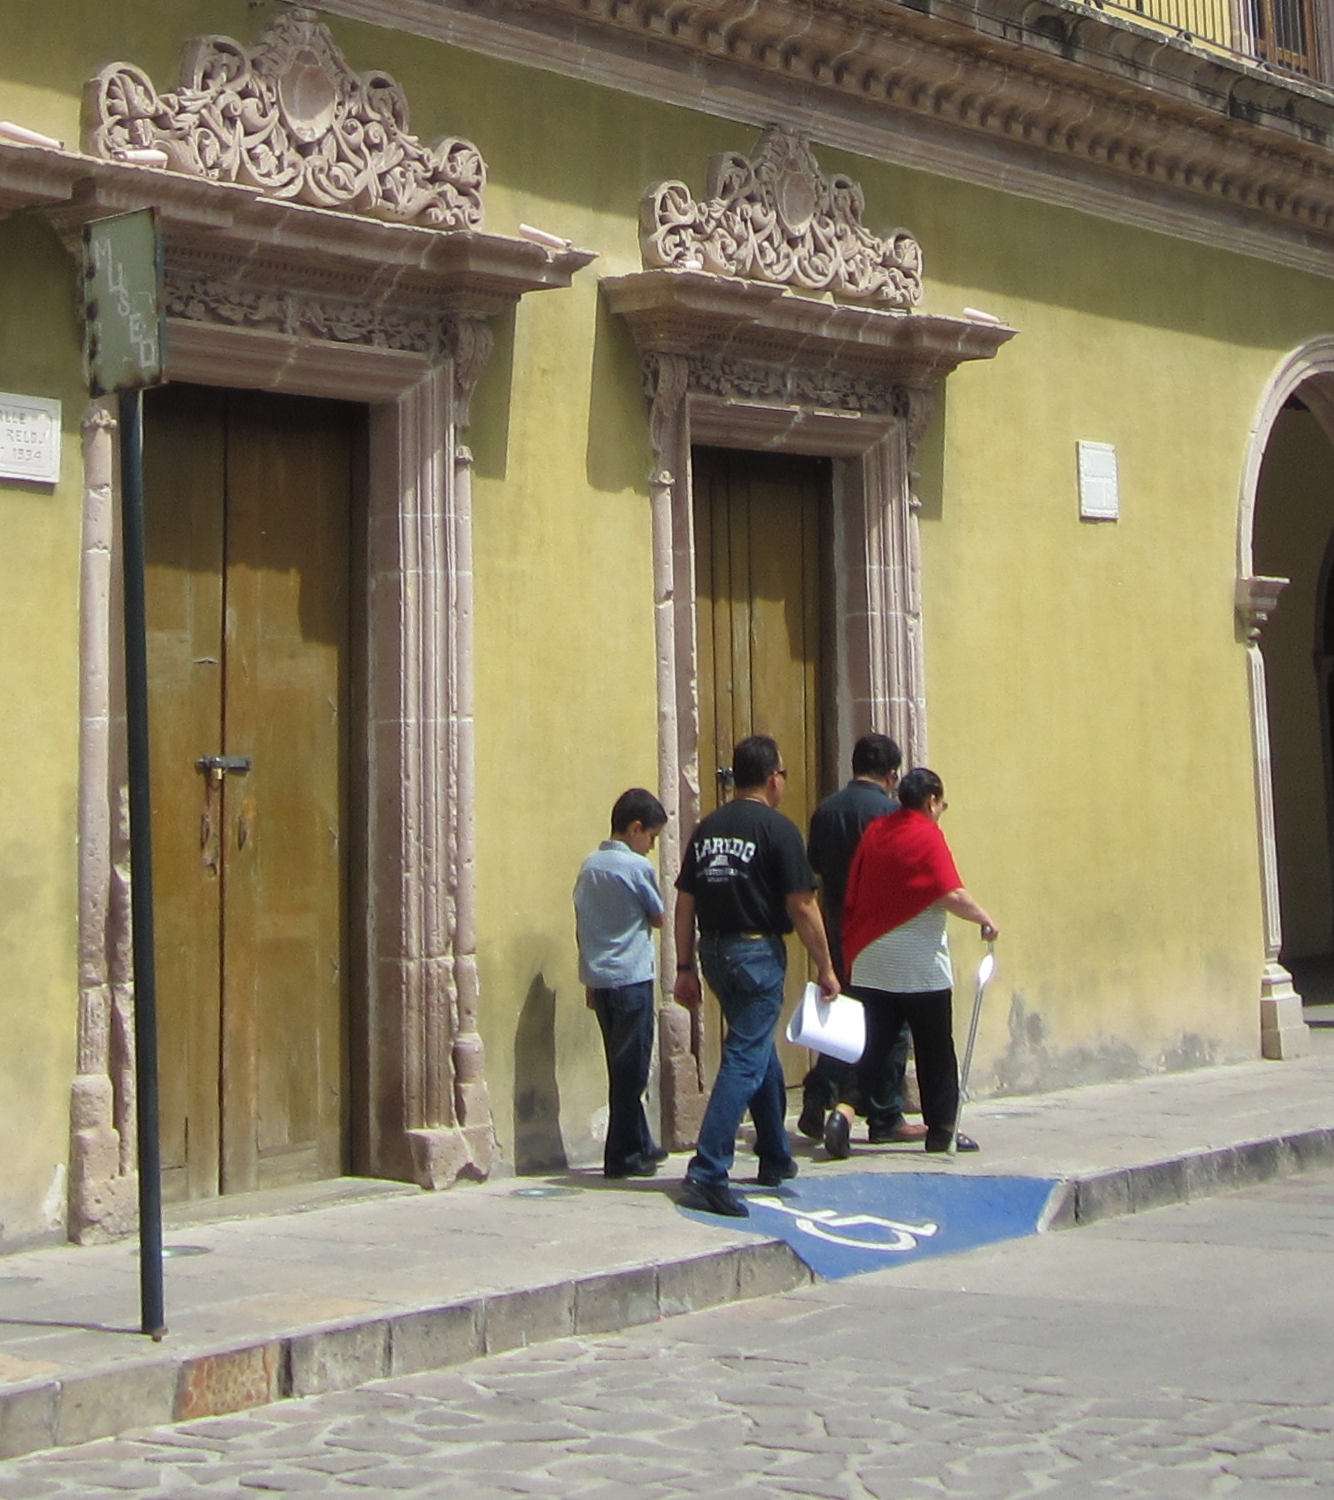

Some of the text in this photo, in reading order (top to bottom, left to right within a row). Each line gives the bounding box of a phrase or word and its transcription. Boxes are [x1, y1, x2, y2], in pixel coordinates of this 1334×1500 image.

[94, 237, 156, 368] MUSEO
[6, 428, 46, 444] RELOJ
[693, 836, 756, 863] LAREDO
